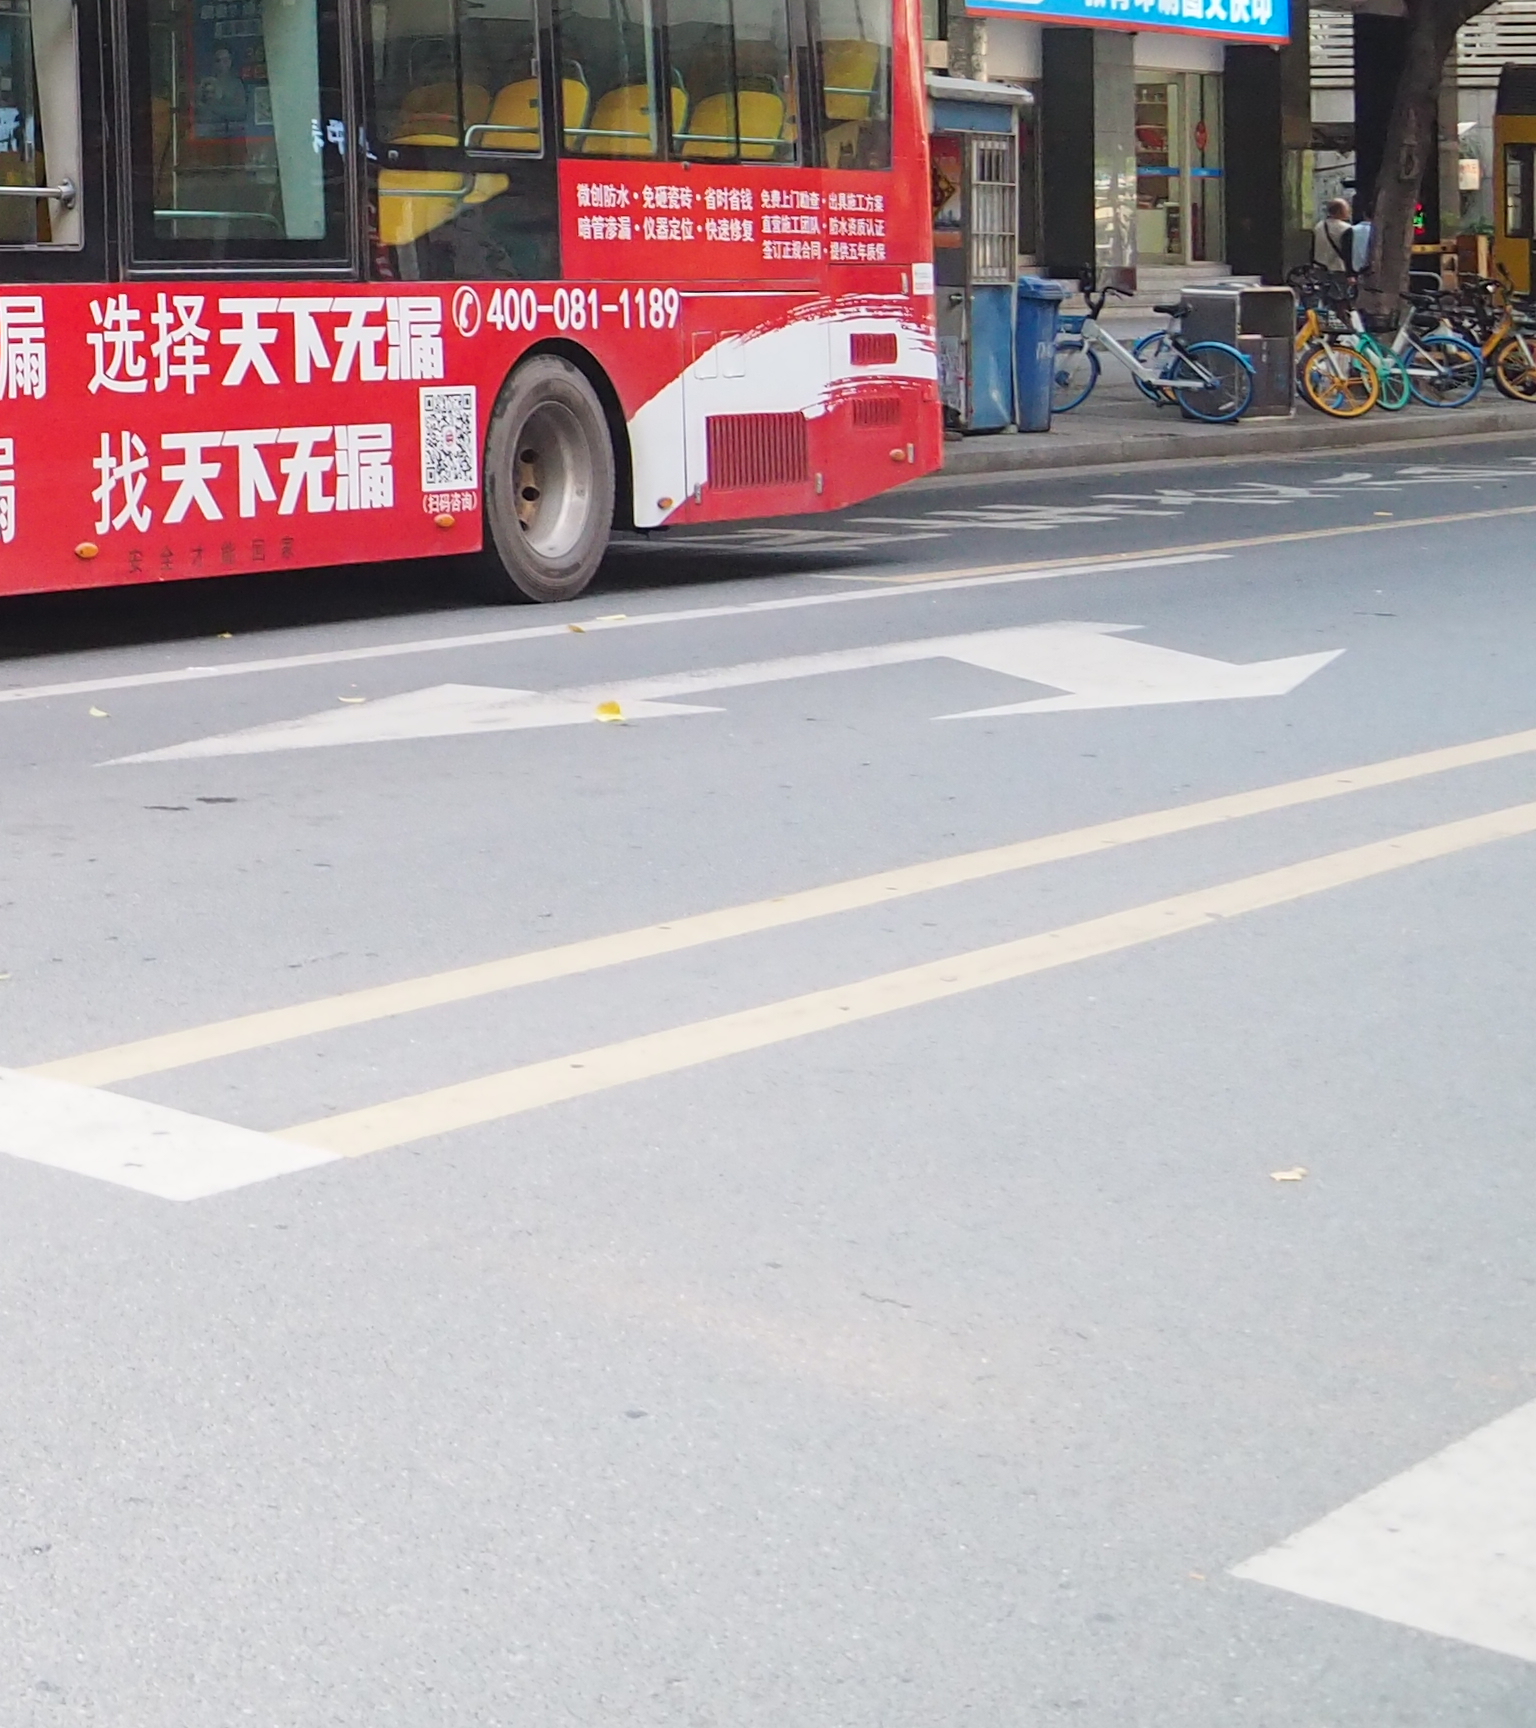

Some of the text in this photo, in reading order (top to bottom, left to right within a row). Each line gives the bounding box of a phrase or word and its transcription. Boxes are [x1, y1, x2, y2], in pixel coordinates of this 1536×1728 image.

[485, 287, 679, 332] 400-081-1189
[90, 422, 394, 536] 找天下无漏
